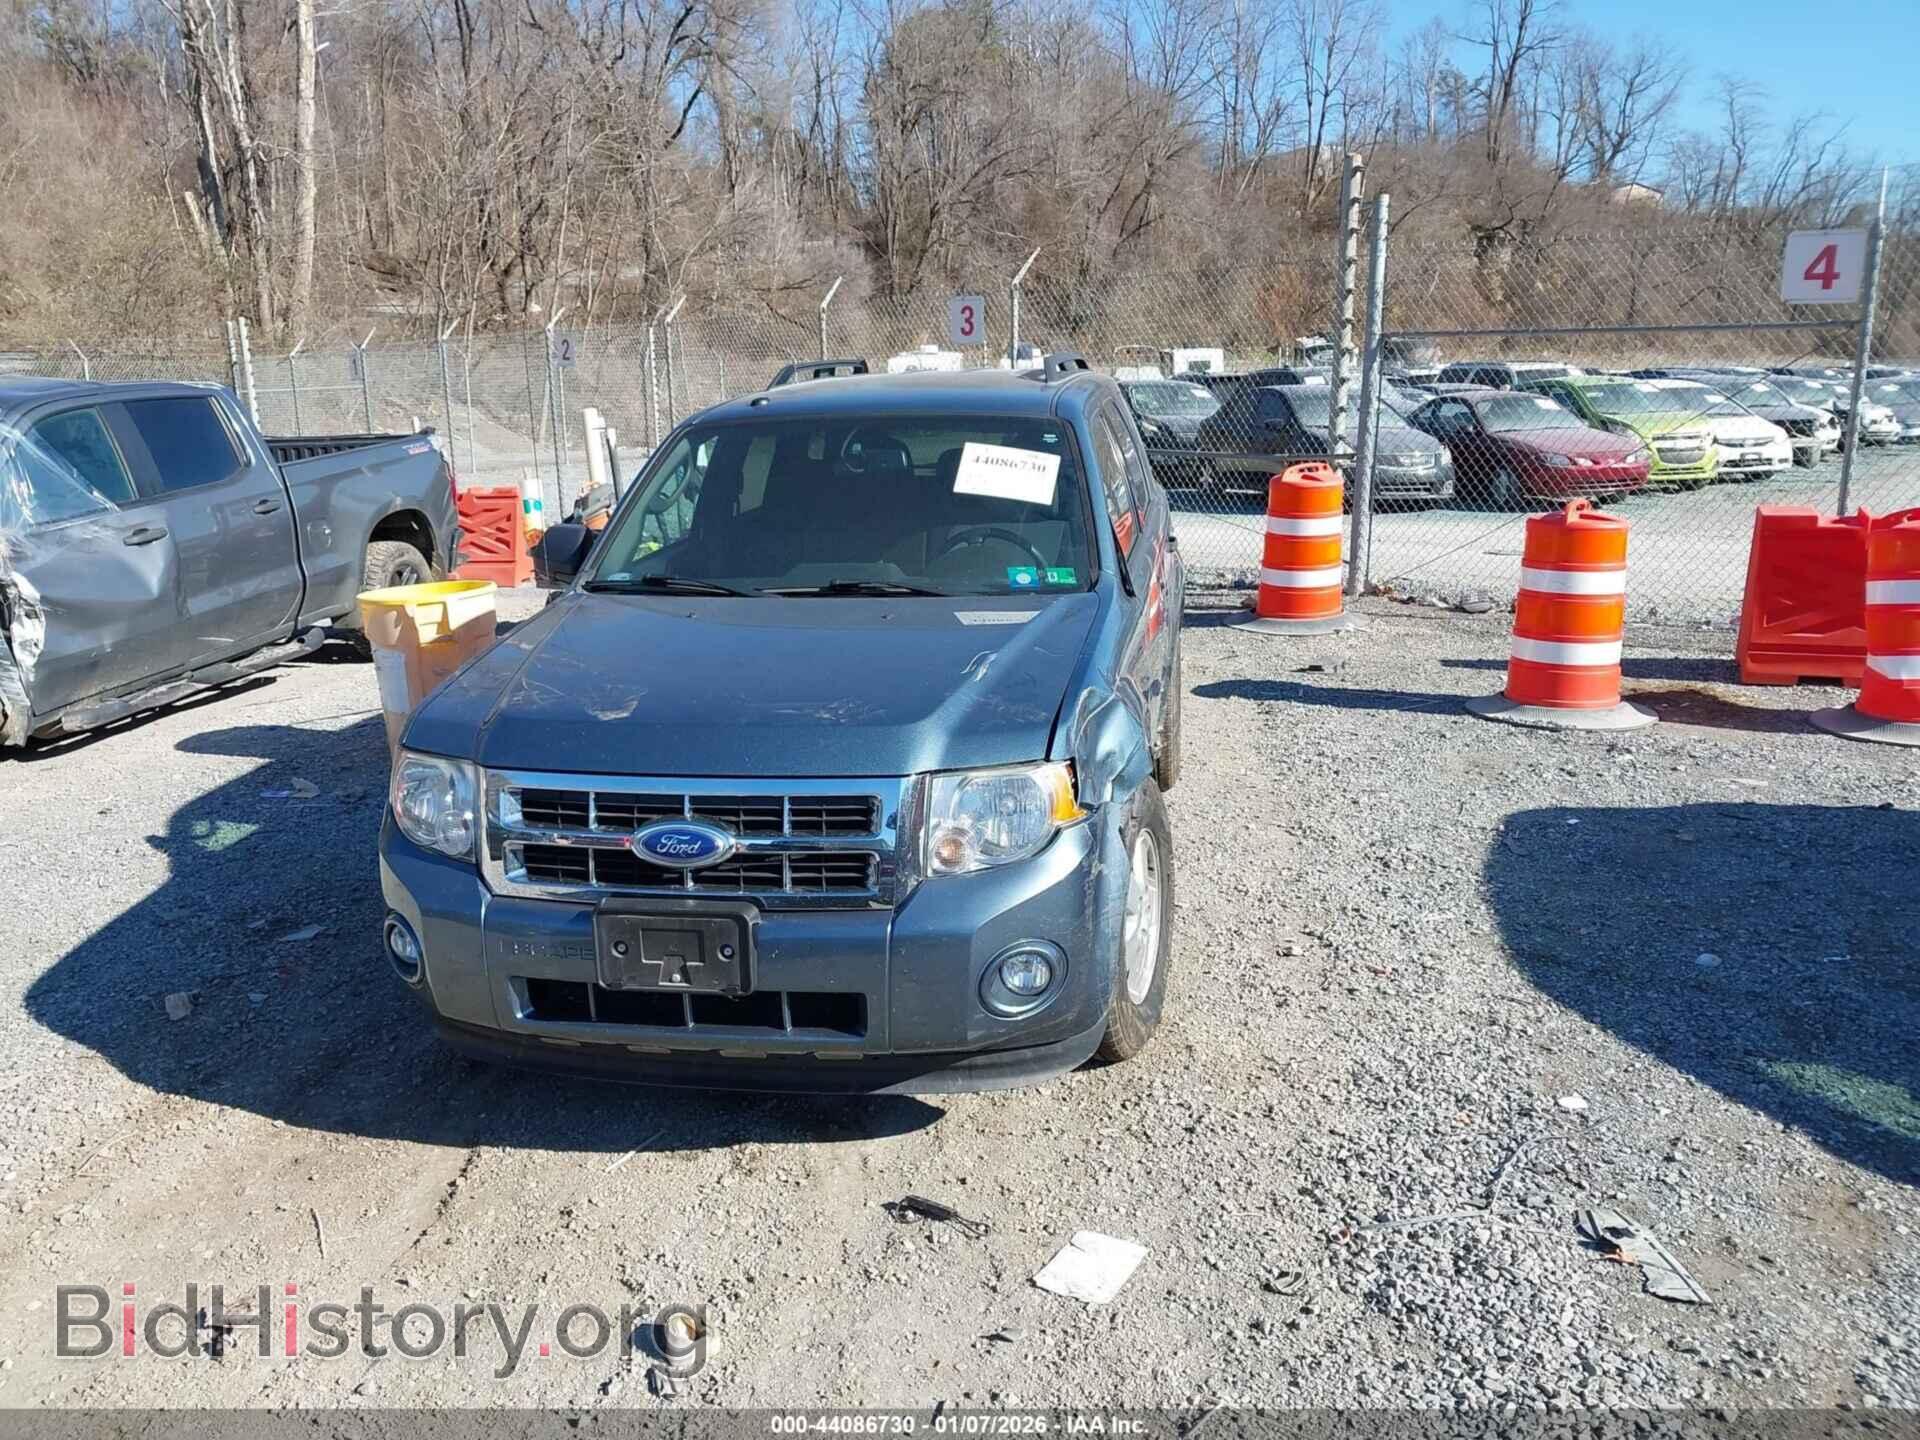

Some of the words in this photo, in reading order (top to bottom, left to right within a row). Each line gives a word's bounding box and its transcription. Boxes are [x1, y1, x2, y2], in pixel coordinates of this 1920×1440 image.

[1804, 244, 1840, 289] 4
[960, 304, 975, 336] 3
[561, 339, 570, 360] 2
[656, 834, 702, 855] Ford
